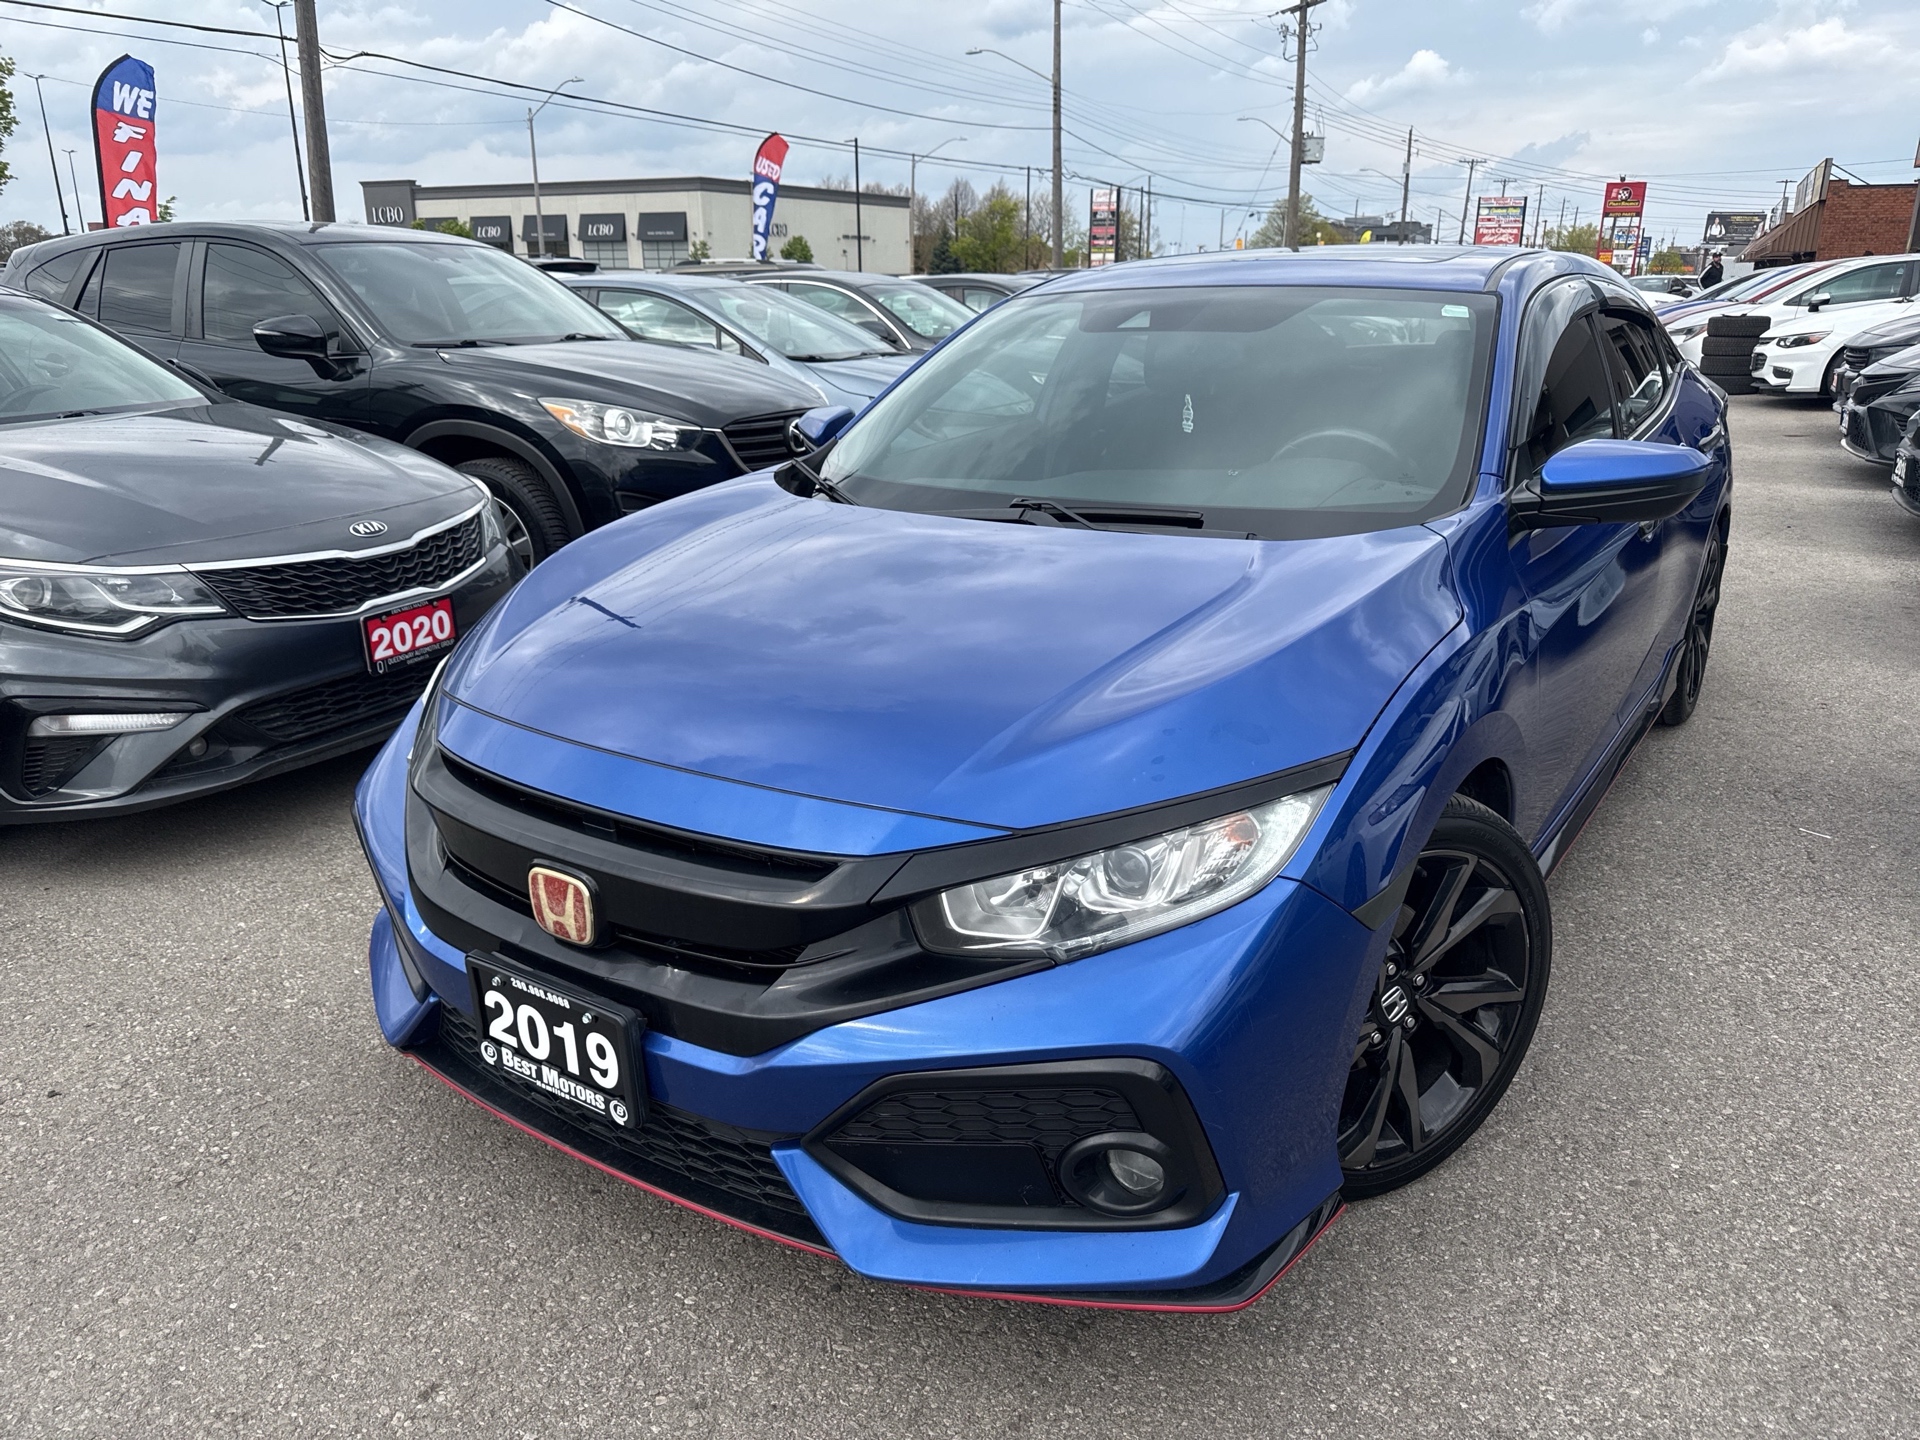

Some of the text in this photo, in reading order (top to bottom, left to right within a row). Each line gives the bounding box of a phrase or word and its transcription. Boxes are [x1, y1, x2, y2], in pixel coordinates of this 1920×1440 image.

[113, 80, 154, 119] WE
[756, 156, 781, 181] USED
[371, 205, 404, 224] LCBO
[752, 181, 775, 260] CAR
[476, 225, 501, 238] LCBO
[587, 223, 614, 237] LCBO
[354, 521, 385, 534] KIA
[371, 609, 451, 661] 2020
[387, 638, 455, 665] QUEENSWAY AUTOMOTIVE GROUP
[484, 989, 619, 1089] 2019
[501, 1046, 606, 1110] BEST MOTORS
